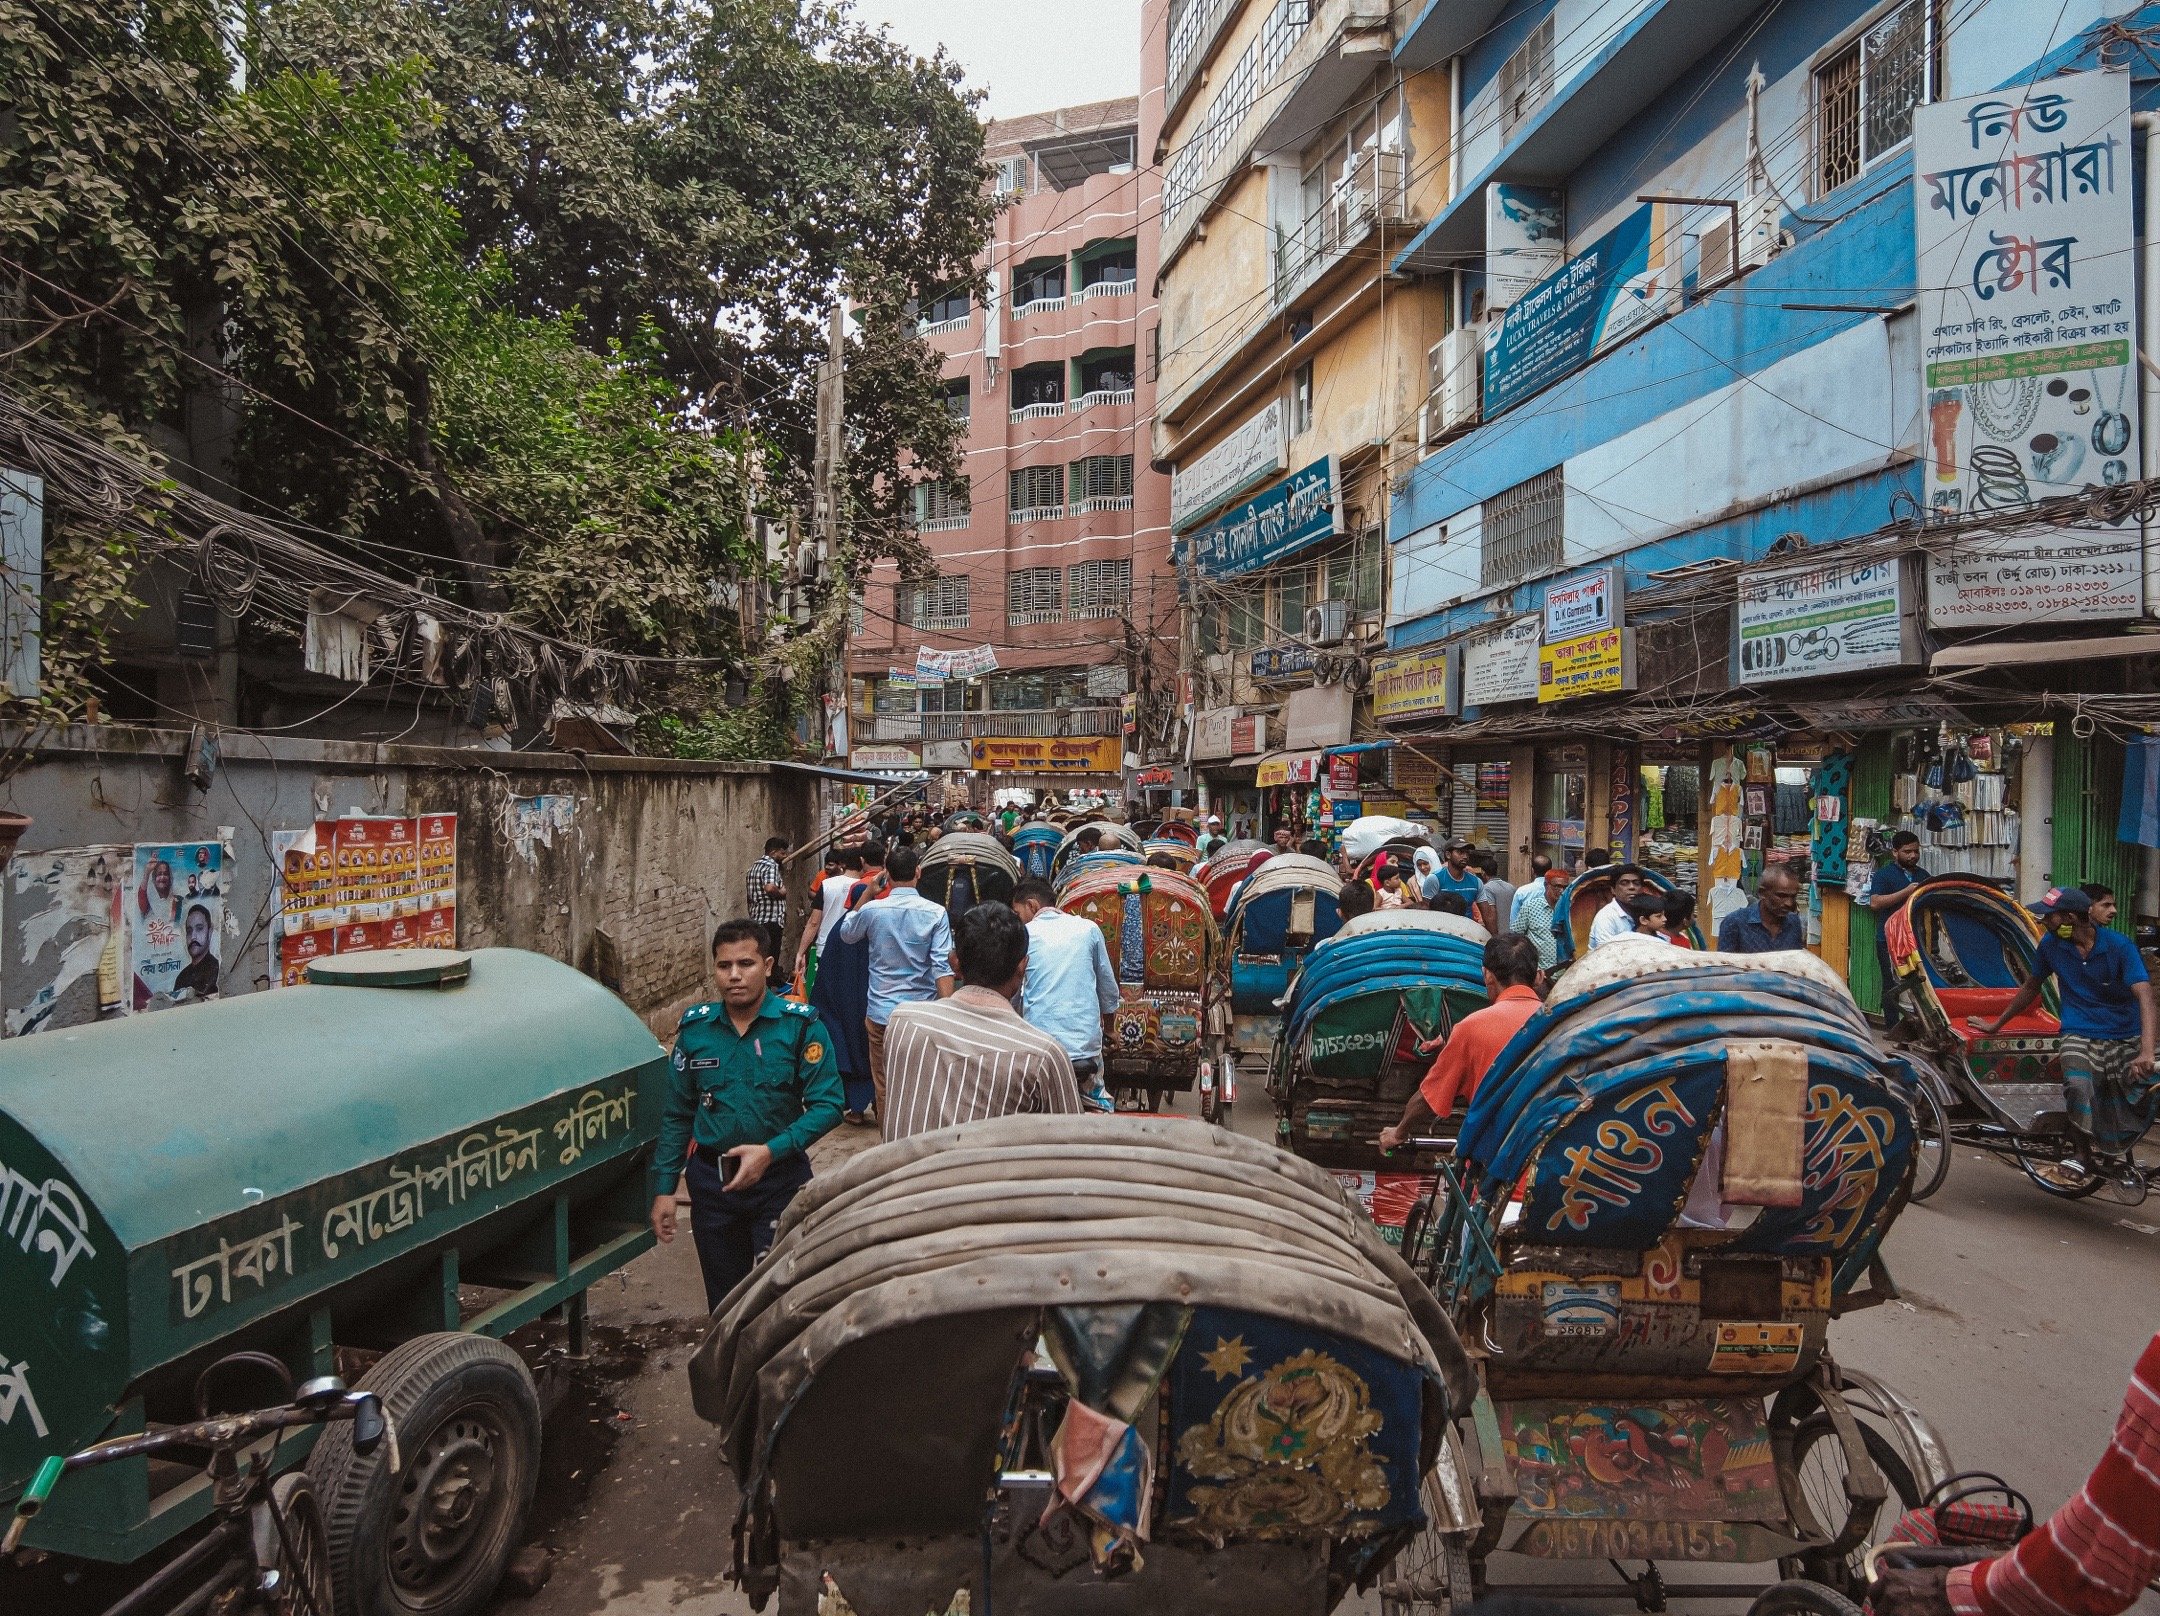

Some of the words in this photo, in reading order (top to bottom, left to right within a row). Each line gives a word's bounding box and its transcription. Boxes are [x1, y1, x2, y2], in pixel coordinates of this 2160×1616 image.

[1961, 95, 2074, 150] নিউ
[1922, 133, 2122, 221] মনোয়ারা
[1973, 230, 2079, 300] ষ্টোর
[1506, 325, 1526, 347] LUCKY
[1527, 304, 1556, 332] TRAVELS
[1556, 299, 1563, 312] &
[1933, 325, 1963, 336] এখানে
[1966, 318, 1985, 333] চাবি
[2092, 299, 2121, 316] আংটি
[1927, 341, 1972, 358] নেলকাটার
[1975, 334, 2010, 352] ইত্যাদি
[2013, 327, 2054, 347] পাইকারী
[2057, 326, 2087, 341] বিক্রয়
[2090, 323, 2110, 336] করা
[2113, 321, 2130, 335] হয়
[1934, 570, 1959, 587] হাজী
[1963, 571, 1989, 583] ভবন
[2025, 566, 2056, 580] রোড)
[2010, 581, 2109, 596] ০১৯৭৩-০৪২৩৩৩
[1566, 602, 1592, 618] Garments
[2036, 594, 2137, 609] ০১৮৪২-১৪২৩৩৩
[158, 958, 181, 973] হাসিনা
[1546, 1077, 1697, 1231] শাওন
[172, 1214, 303, 1319] ঢাকা
[322, 1126, 542, 1259] মেট্রোপলিটন
[553, 1088, 638, 1166] পুলিশ
